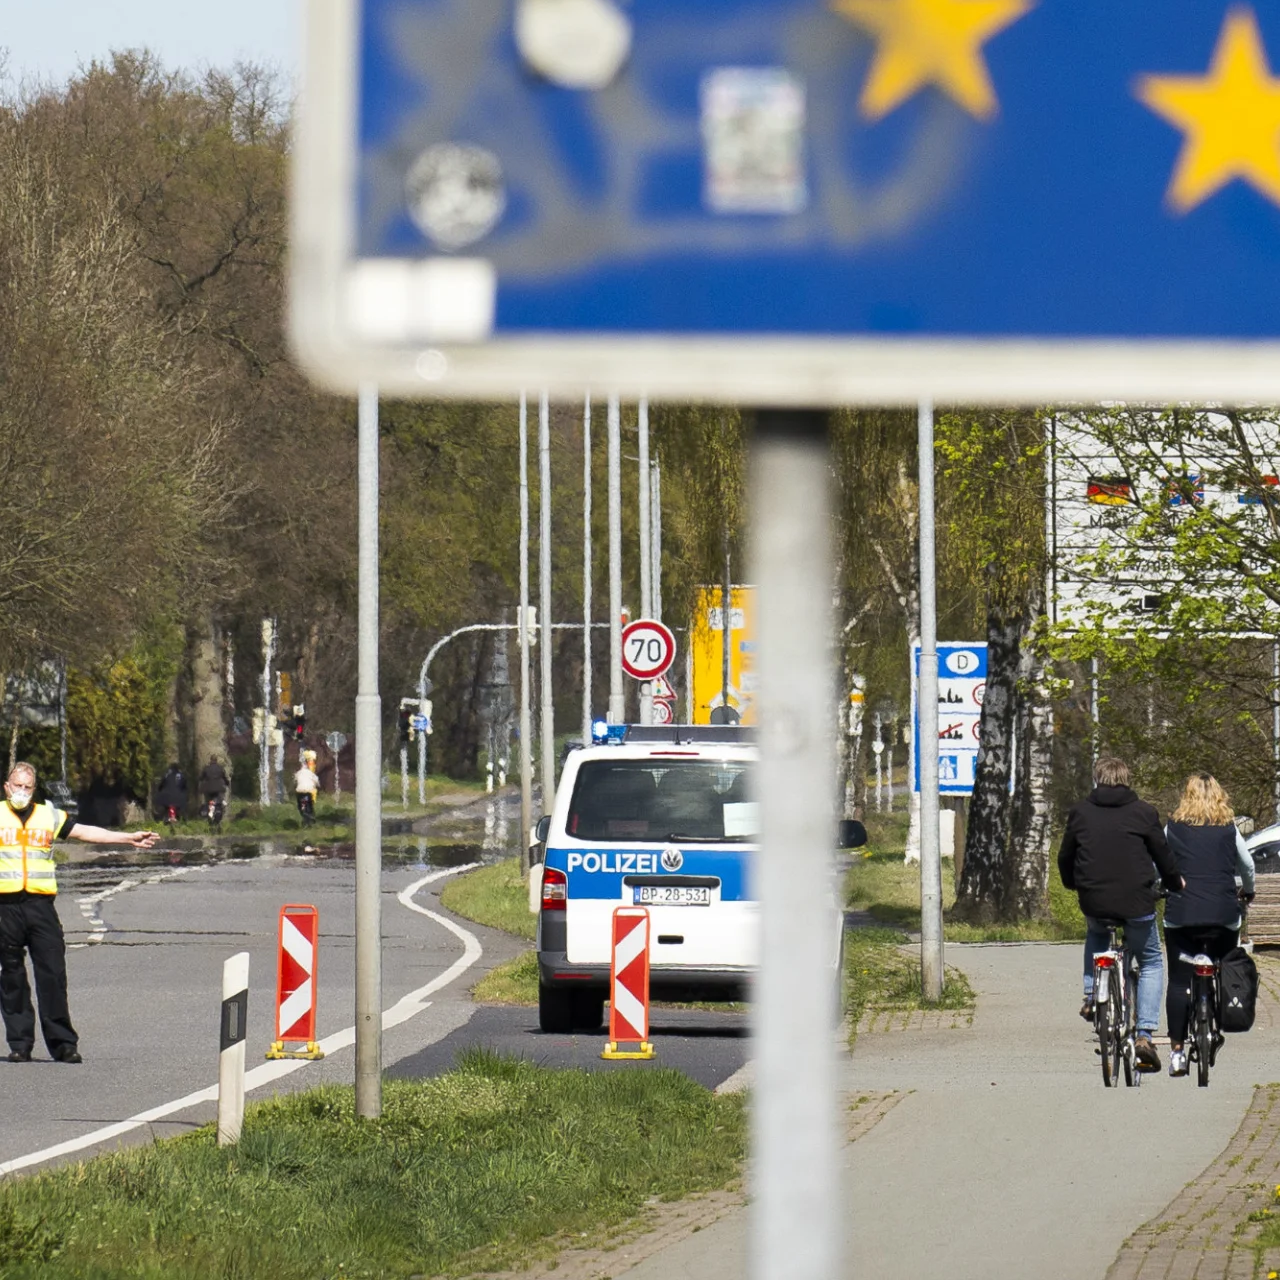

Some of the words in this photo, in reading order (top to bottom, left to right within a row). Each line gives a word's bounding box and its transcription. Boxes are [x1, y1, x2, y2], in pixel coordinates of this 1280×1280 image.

[630, 638, 662, 663] 70
[956, 654, 969, 670] D
[567, 852, 658, 873] POLIZEI
